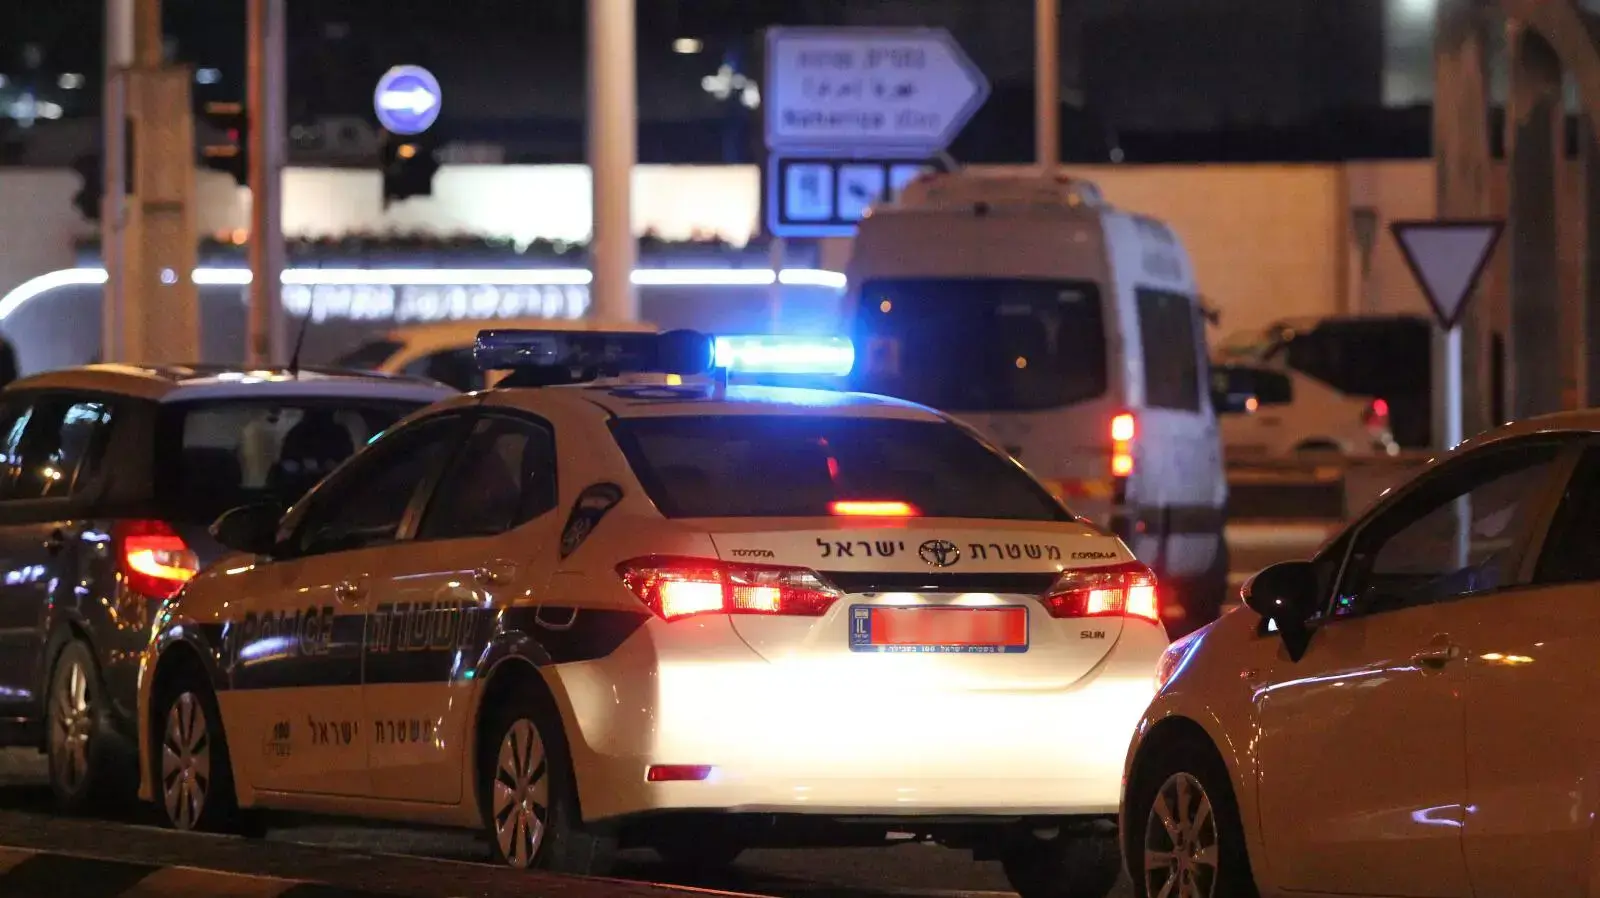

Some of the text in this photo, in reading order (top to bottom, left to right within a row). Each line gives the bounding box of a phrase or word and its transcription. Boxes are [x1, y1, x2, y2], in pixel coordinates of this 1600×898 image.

[731, 549, 775, 558] TOYOTA
[816, 537, 1061, 561] משטרת ישראל
[1071, 551, 1117, 560] COROLLA
[237, 604, 335, 656] POLICE
[856, 618, 867, 634] IL
[1080, 630, 1106, 639] SUN
[307, 713, 433, 746] משטרת ישראל
